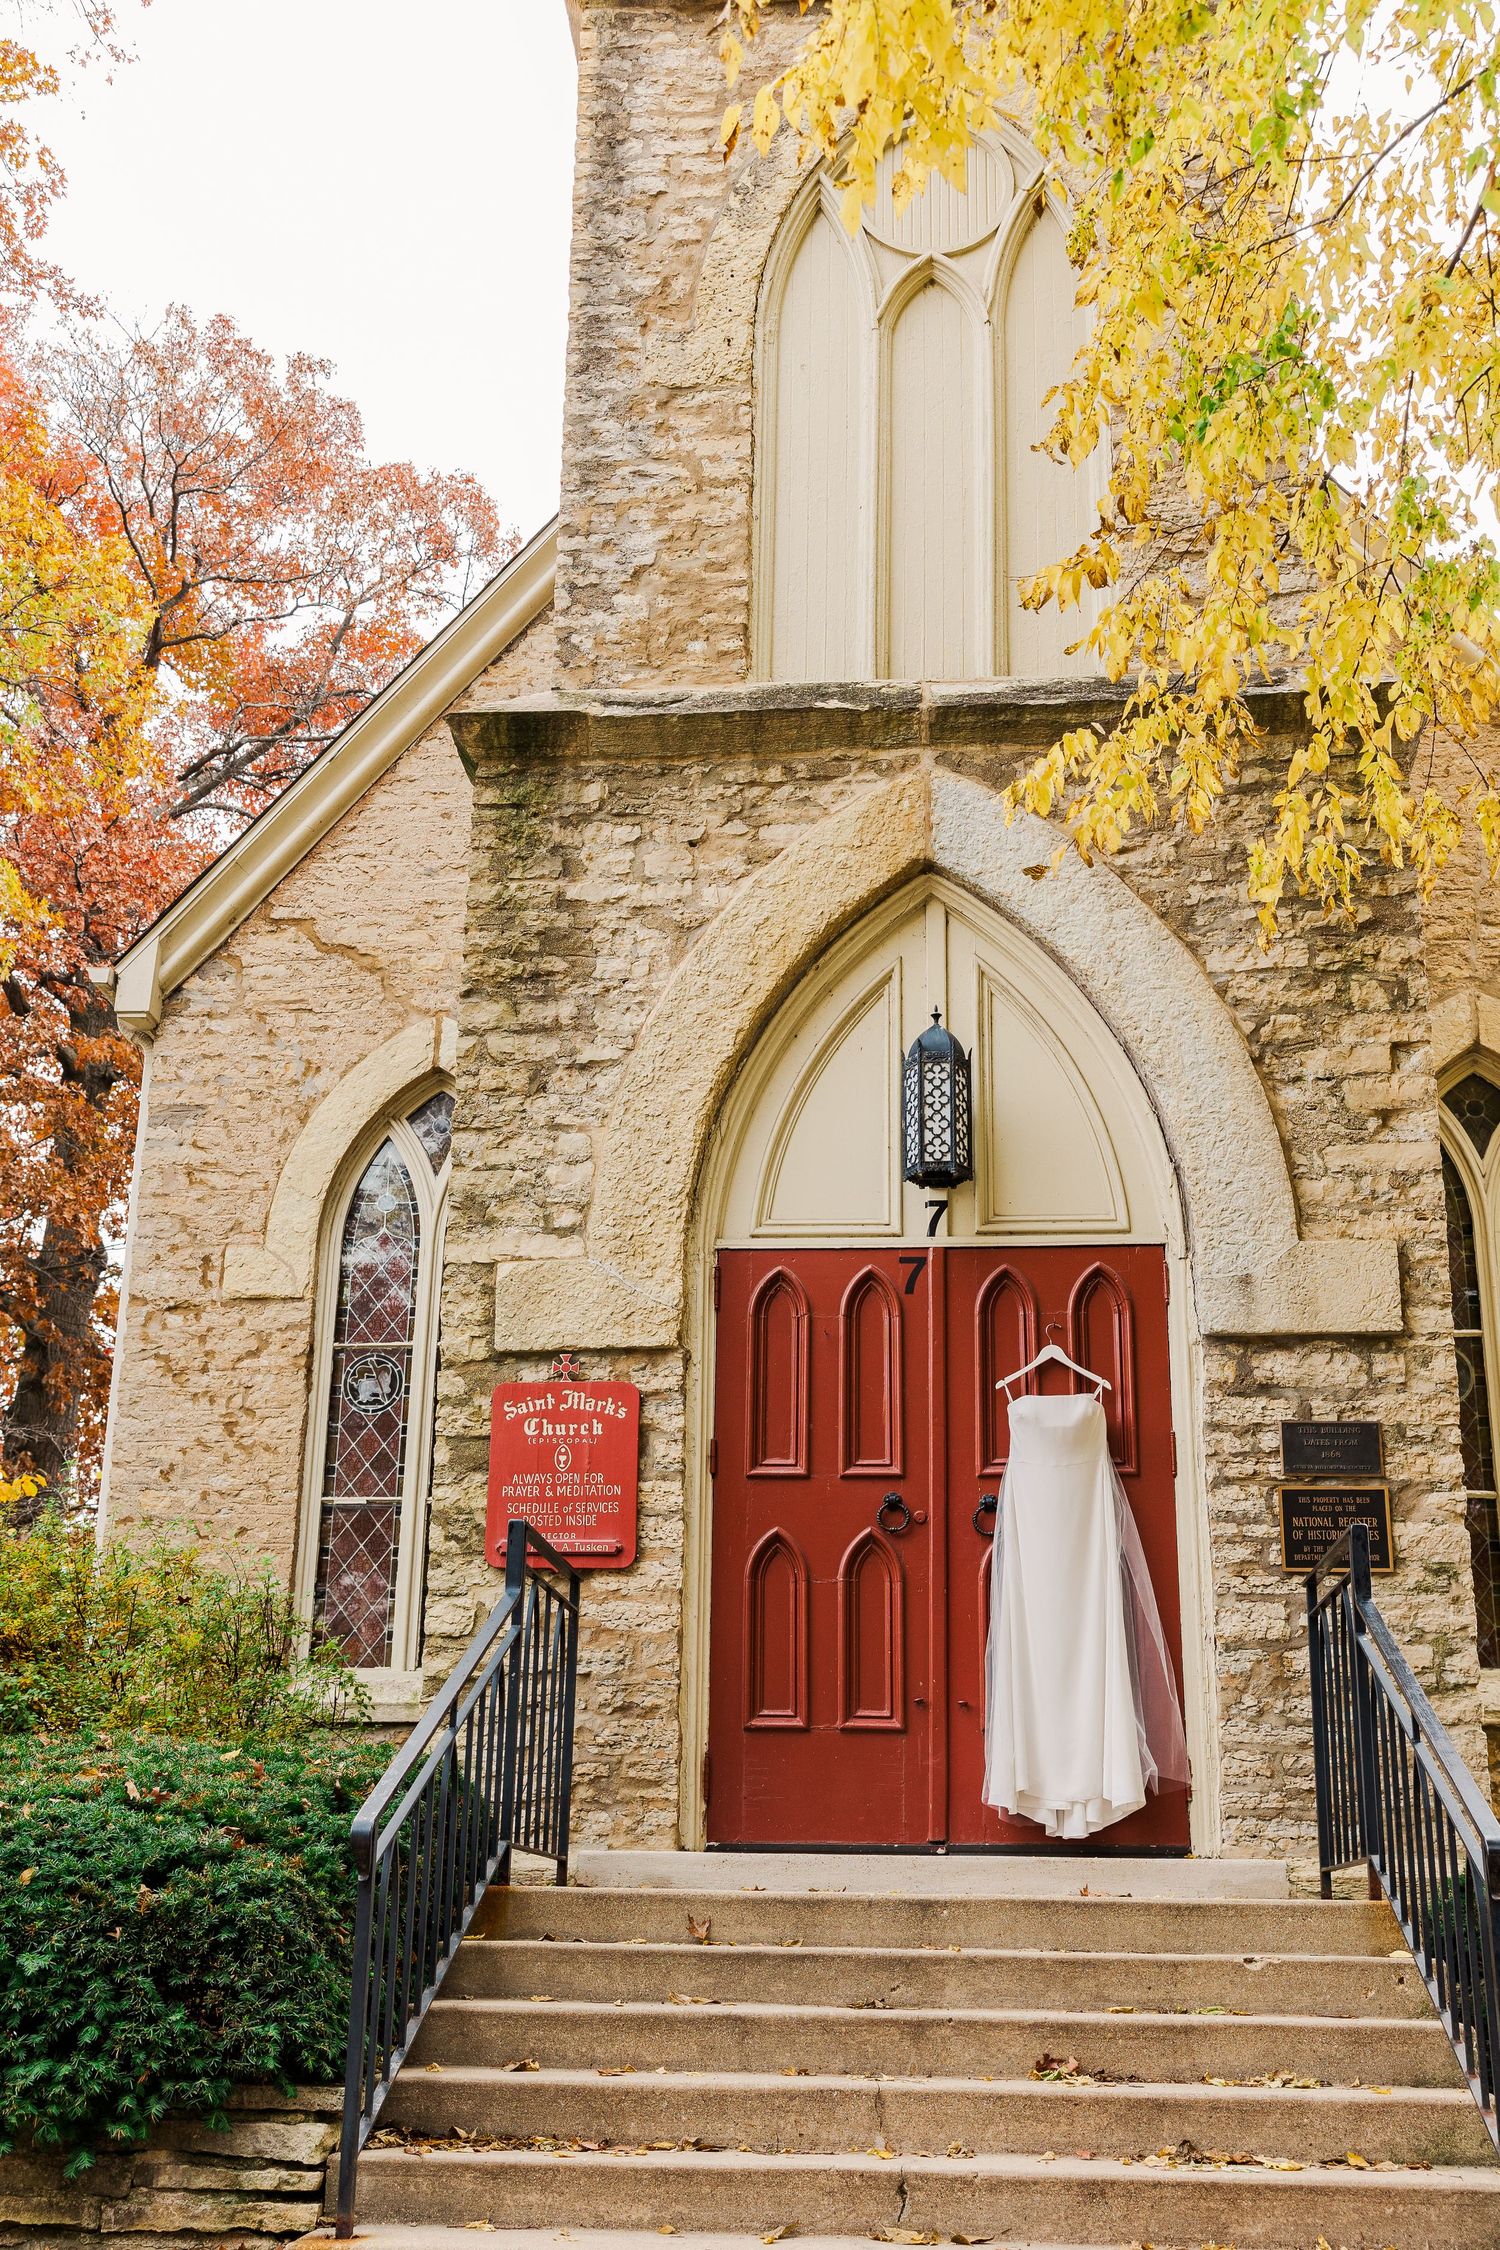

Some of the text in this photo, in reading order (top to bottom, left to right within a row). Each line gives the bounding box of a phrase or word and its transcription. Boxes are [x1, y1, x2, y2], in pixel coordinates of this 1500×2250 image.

[925, 1200, 948, 1237] 7
[899, 1257, 927, 1294] 7
[503, 1390, 628, 1420] Saint Mark's
[523, 1417, 604, 1436] Church
[1297, 1426, 1361, 1434] THIS BUILDING
[512, 1472, 604, 1485] ALWAYS OPEN FOR
[502, 1484, 621, 1497] PRAYER & MEDITATION
[506, 1501, 620, 1514] SCHEDULE of SERVICES
[565, 1514, 597, 1526] INSIDE
[1292, 1516, 1378, 1527] NATIONAL REGISTER
[1292, 1529, 1304, 1540] OF
[574, 1542, 609, 1552] Tusken
